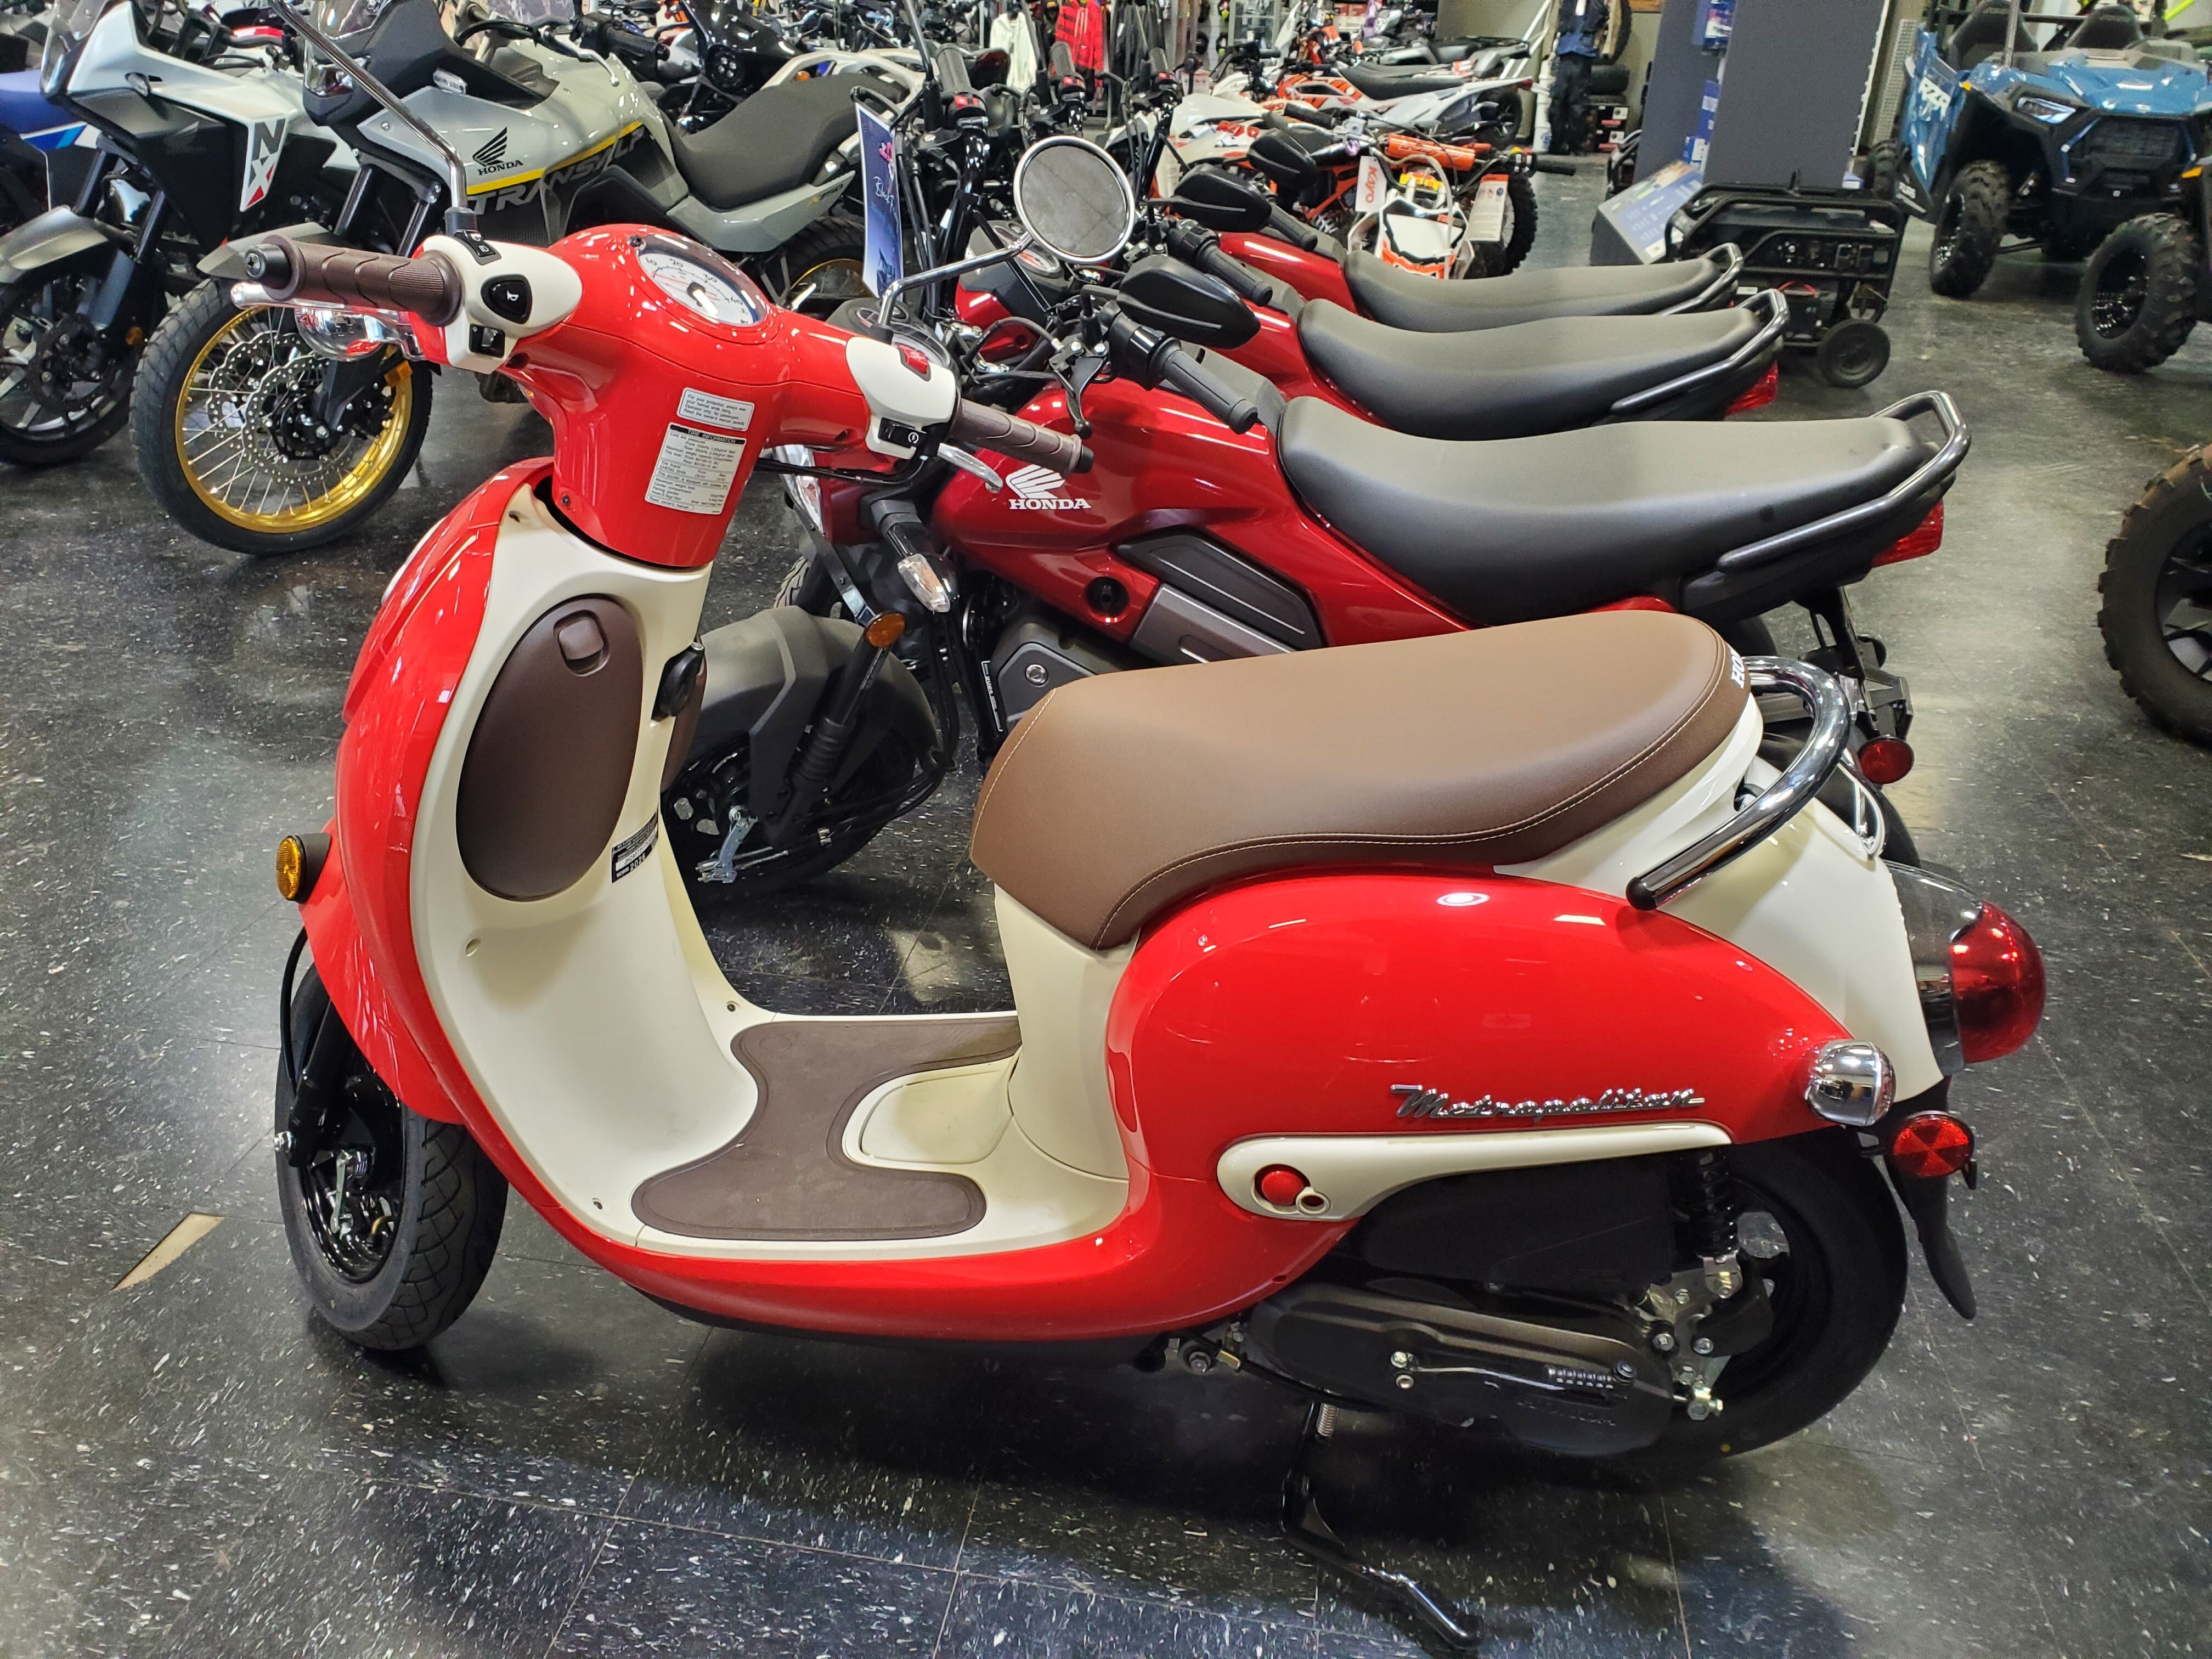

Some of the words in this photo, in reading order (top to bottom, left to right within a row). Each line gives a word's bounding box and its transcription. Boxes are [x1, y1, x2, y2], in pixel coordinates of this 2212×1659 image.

[1918, 77, 1951, 120] RZR
[477, 159, 523, 176] HONDA
[1365, 166, 1378, 204] KAYO
[645, 256, 658, 266] 10
[669, 258, 684, 268] 20
[702, 273, 718, 283] 30
[702, 432, 737, 444] INFORMATION
[1008, 498, 1092, 510] HONDA
[630, 852, 646, 872] 2026
[1390, 1084, 1706, 1122] Metropolitan
